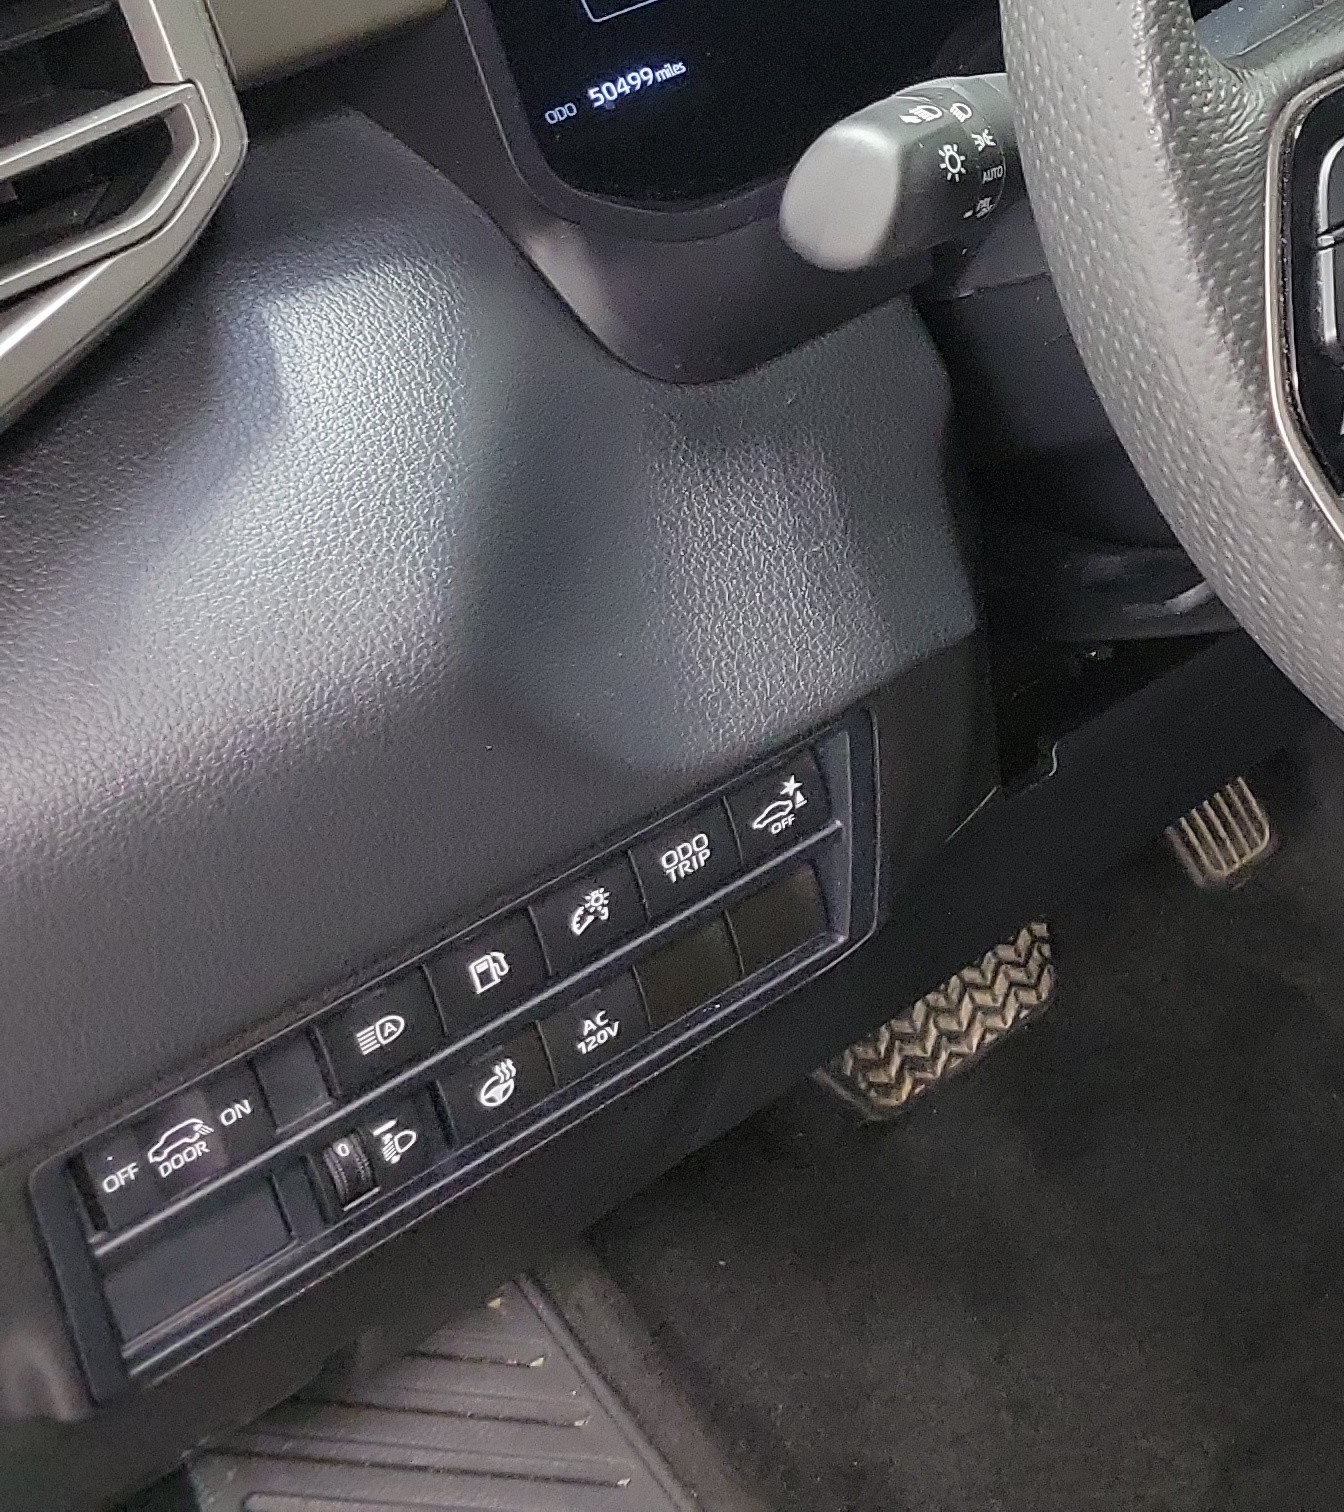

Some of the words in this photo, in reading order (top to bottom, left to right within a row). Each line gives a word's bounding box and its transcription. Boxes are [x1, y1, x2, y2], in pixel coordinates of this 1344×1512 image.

[544, 102, 578, 126] ODO
[588, 66, 654, 108] 50499
[654, 59, 687, 83] miles
[982, 165, 1004, 185] AUTO
[770, 814, 796, 835] OFF
[660, 833, 709, 870] ODO
[664, 848, 711, 884] TRIP
[577, 1020, 620, 1055] 120V
[582, 1010, 610, 1036] AC
[219, 1099, 252, 1126] ON
[158, 1141, 211, 1178] DOOR
[101, 1162, 139, 1194] OFF
